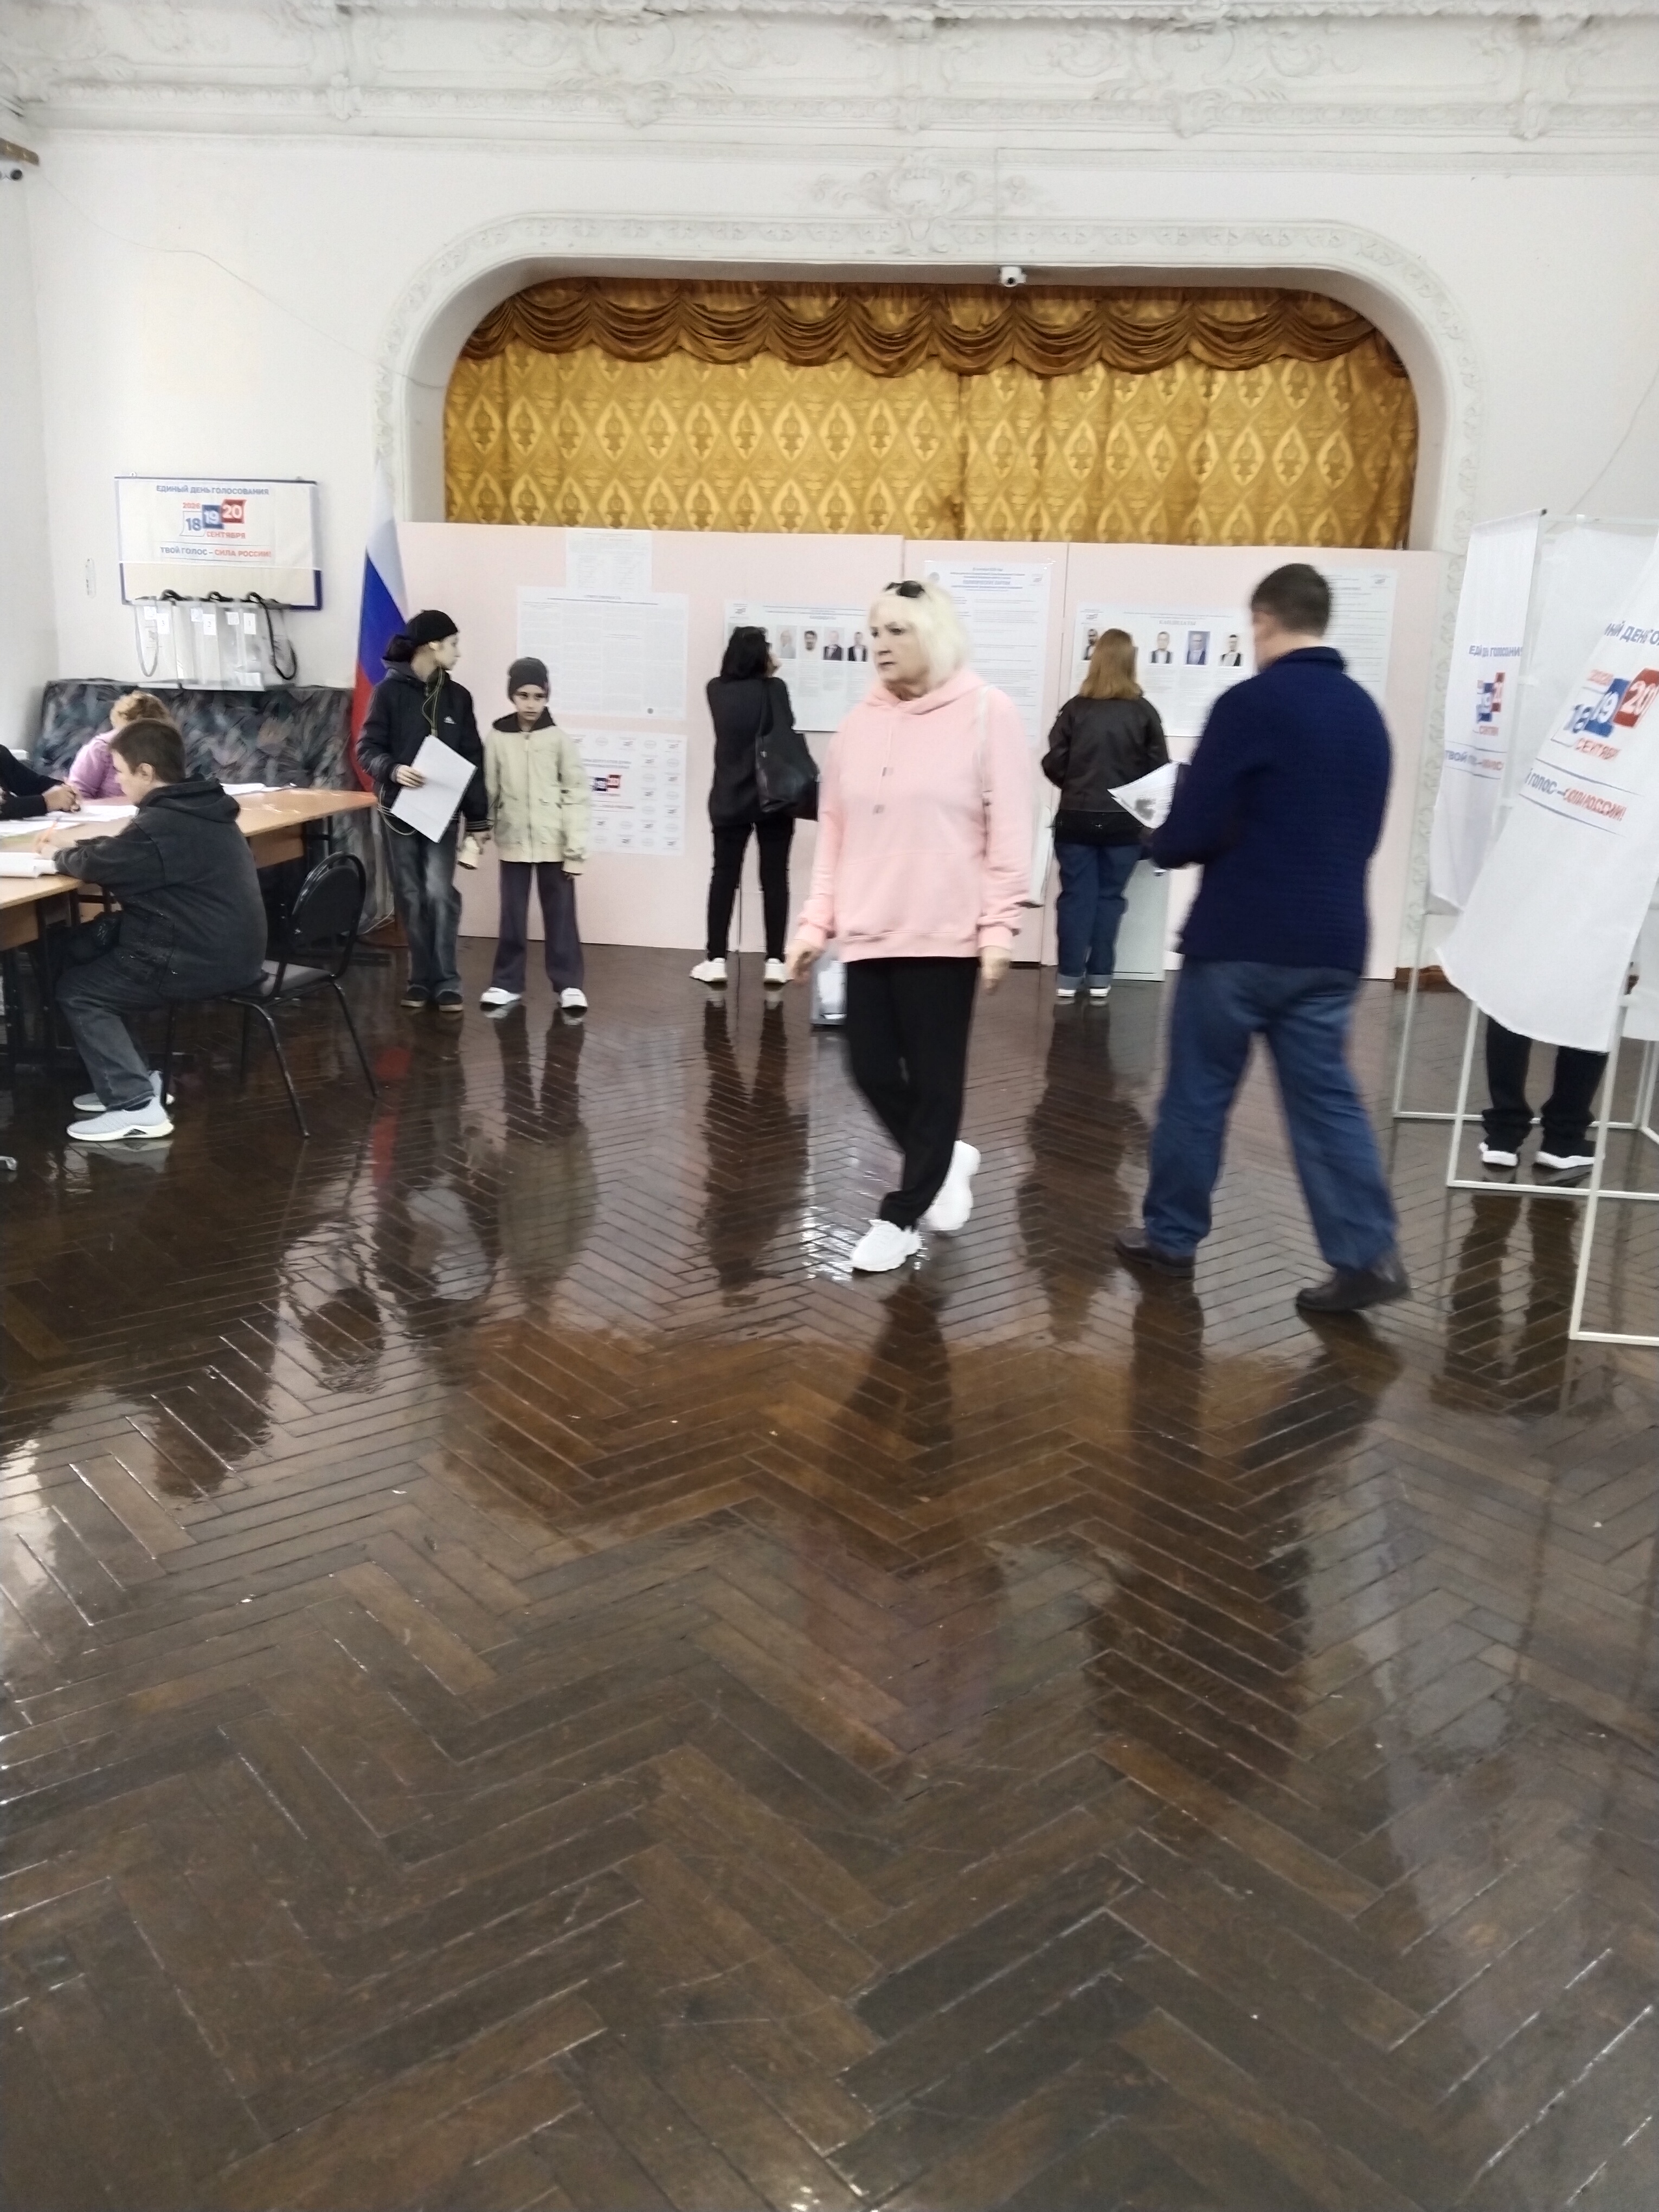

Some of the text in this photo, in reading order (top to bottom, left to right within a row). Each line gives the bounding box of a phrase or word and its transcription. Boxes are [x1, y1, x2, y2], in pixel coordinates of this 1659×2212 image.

[203, 510, 220, 524] 19
[222, 504, 243, 519] 20
[185, 517, 202, 531] 18
[181, 548, 208, 556] ГОЛОС
